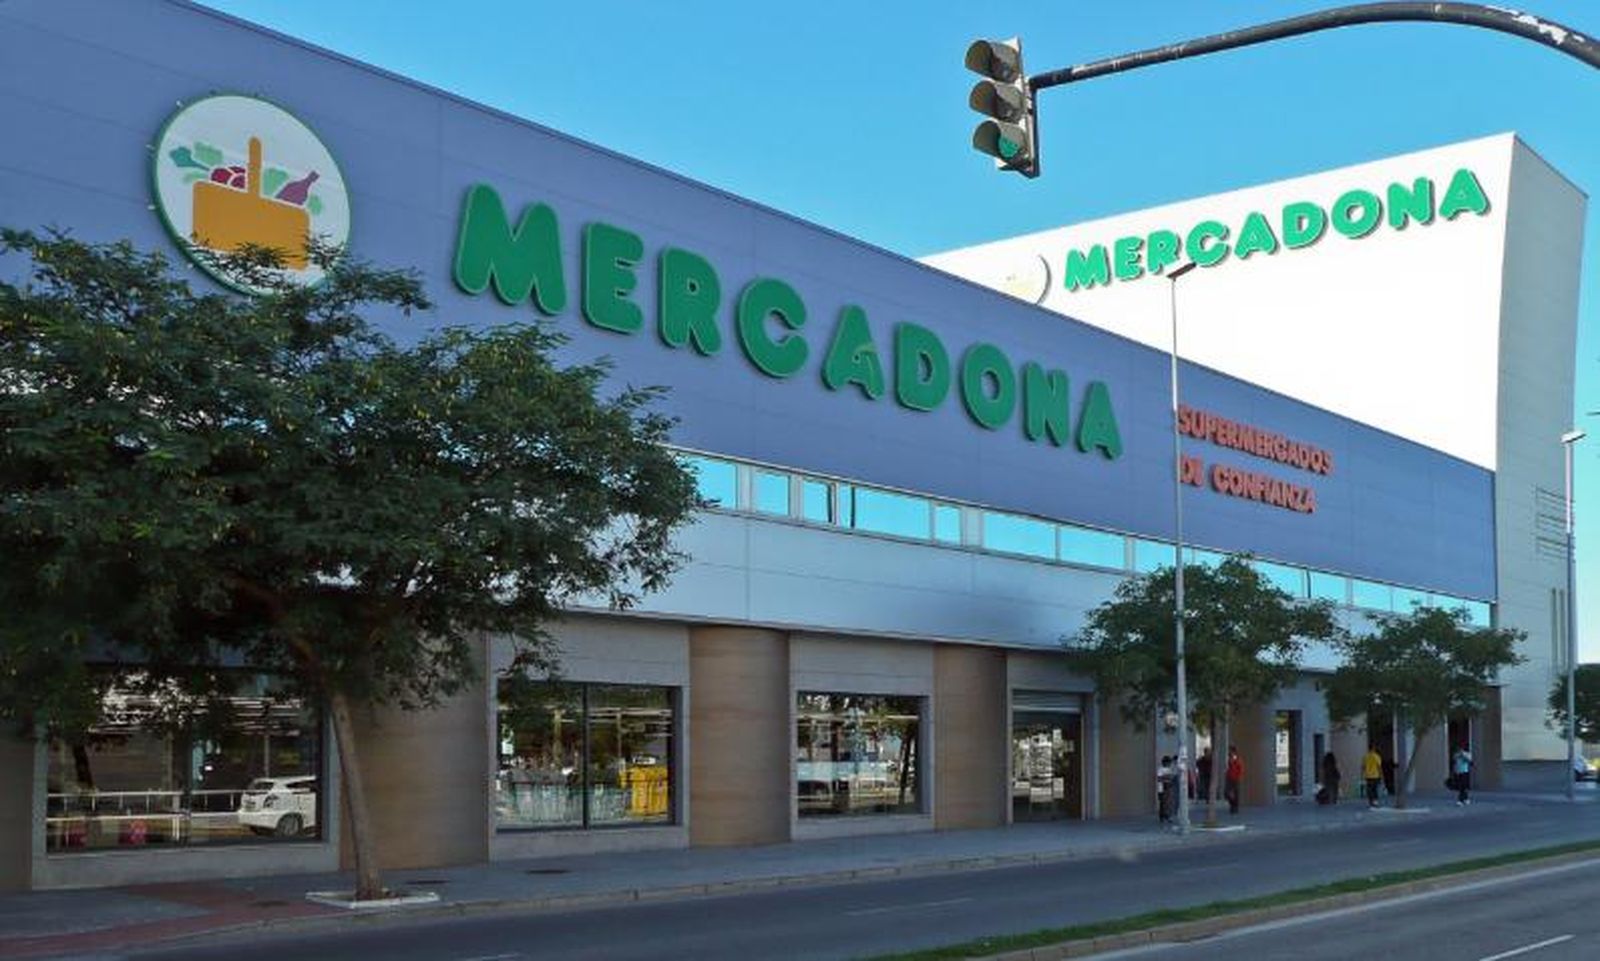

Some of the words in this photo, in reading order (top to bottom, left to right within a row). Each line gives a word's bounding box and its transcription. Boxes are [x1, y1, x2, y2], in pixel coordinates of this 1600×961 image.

[1063, 168, 1491, 292] MERCADONA
[453, 183, 1124, 460] MERCADONA
[1178, 404, 1333, 475] SUPERMERCADOS
[1212, 464, 1316, 513] CONFIANZA
